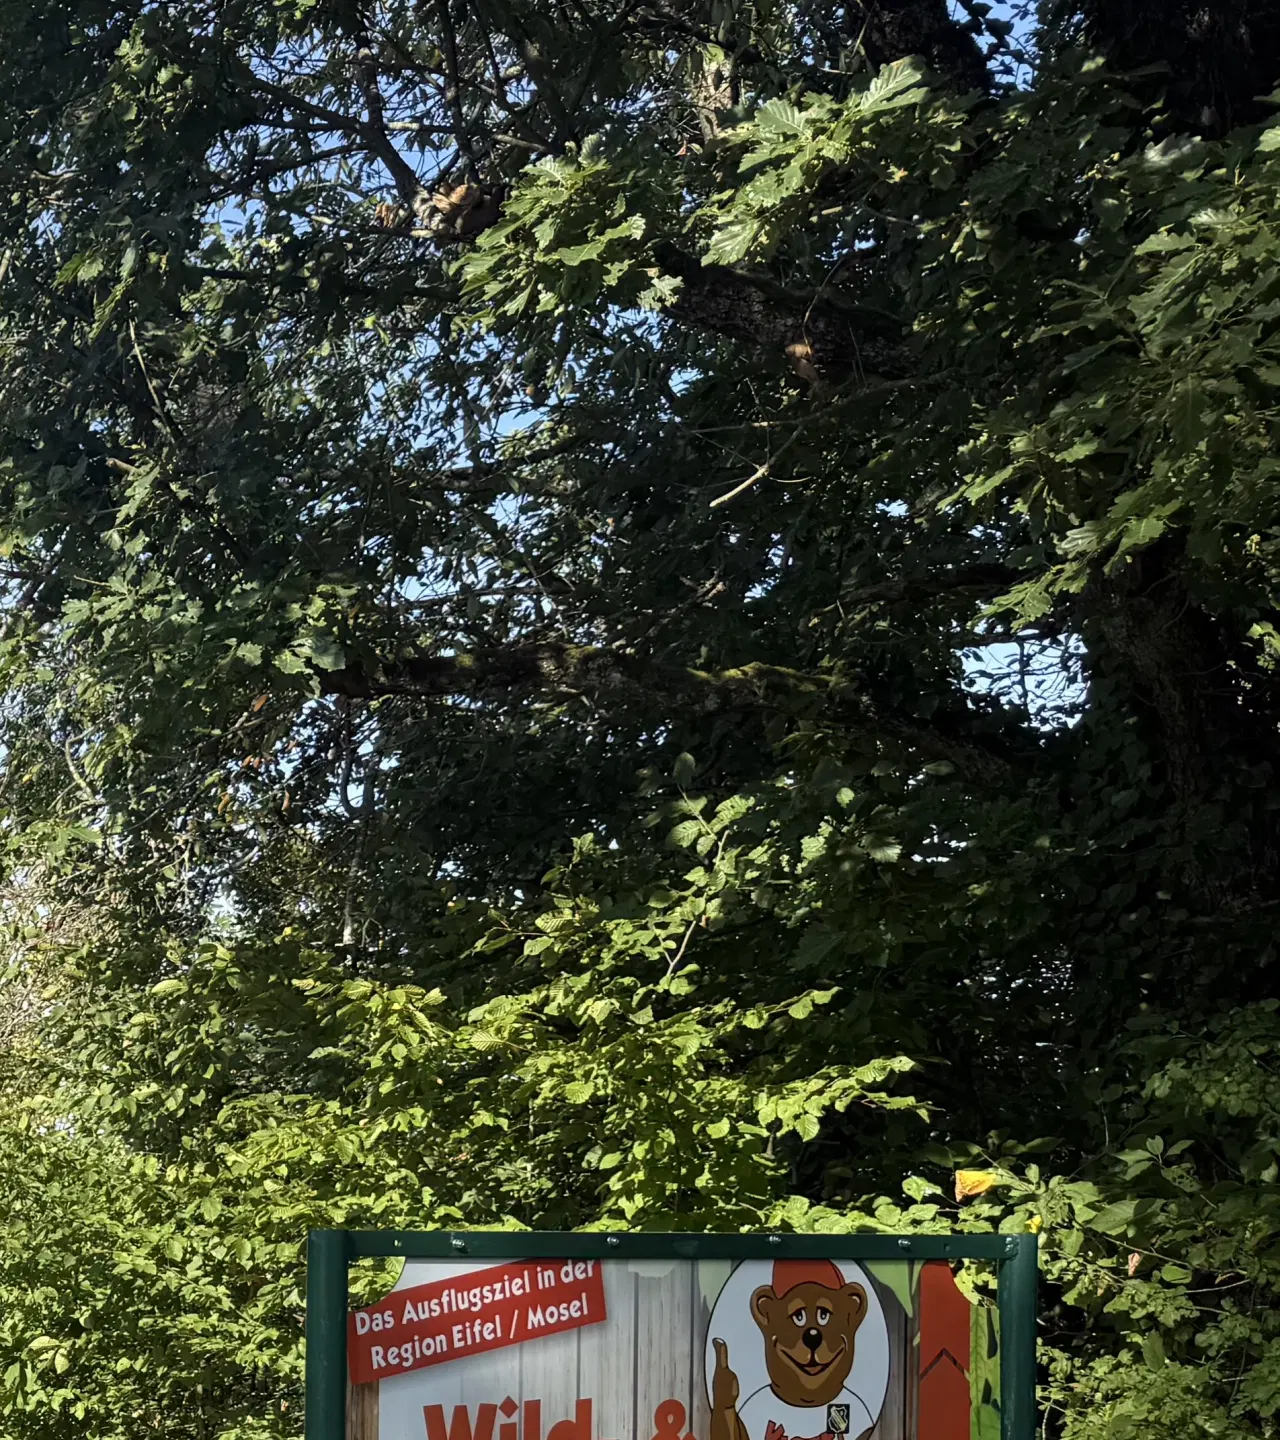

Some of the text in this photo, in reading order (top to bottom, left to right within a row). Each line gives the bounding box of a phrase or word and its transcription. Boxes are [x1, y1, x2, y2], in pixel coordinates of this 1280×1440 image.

[355, 1259, 594, 1335] Das Ausflugsziel in der
[370, 1292, 589, 1370] Region Eifel / Mosel
